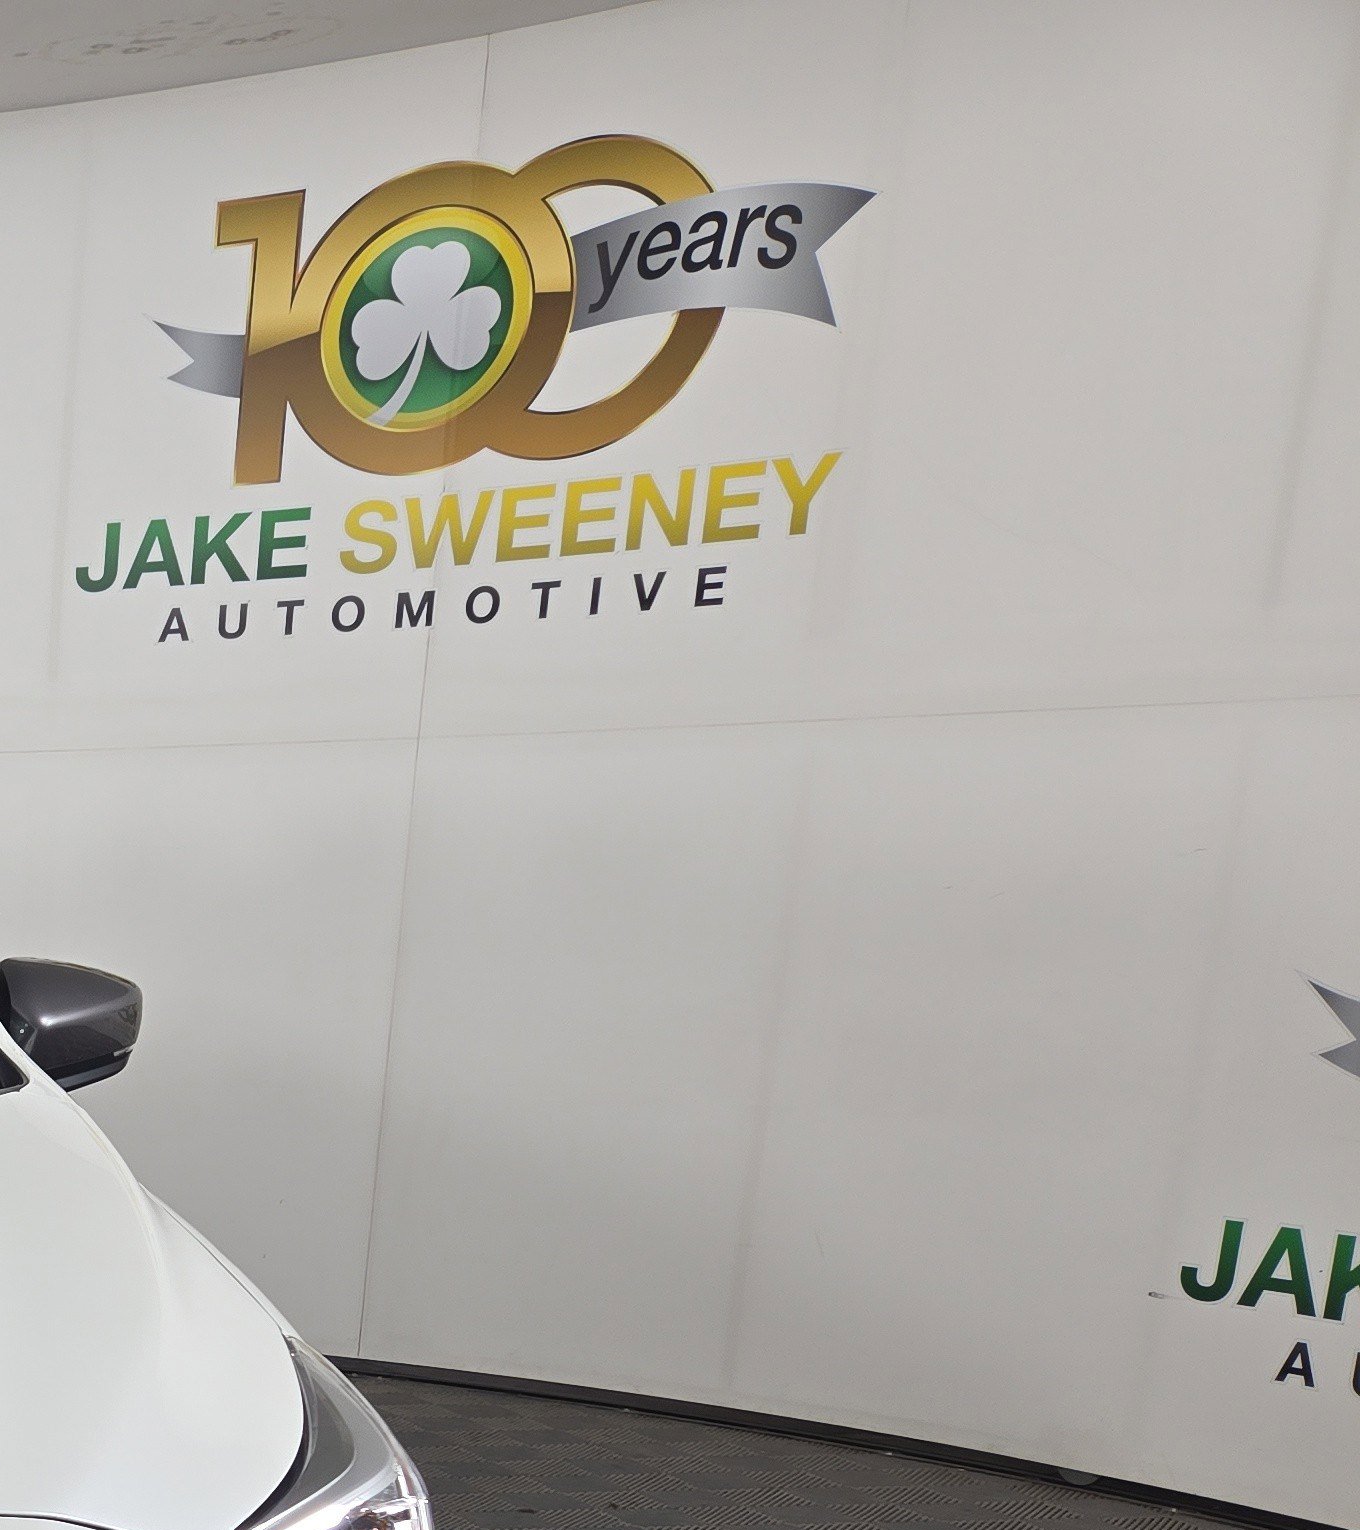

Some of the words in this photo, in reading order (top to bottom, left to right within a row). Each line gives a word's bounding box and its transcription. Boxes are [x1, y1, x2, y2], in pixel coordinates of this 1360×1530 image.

[216, 134, 723, 486] 100
[587, 202, 803, 314] years
[75, 507, 312, 593] JAKE
[340, 452, 843, 575] SWEENEY
[157, 567, 728, 643] AUTOMOTIVE
